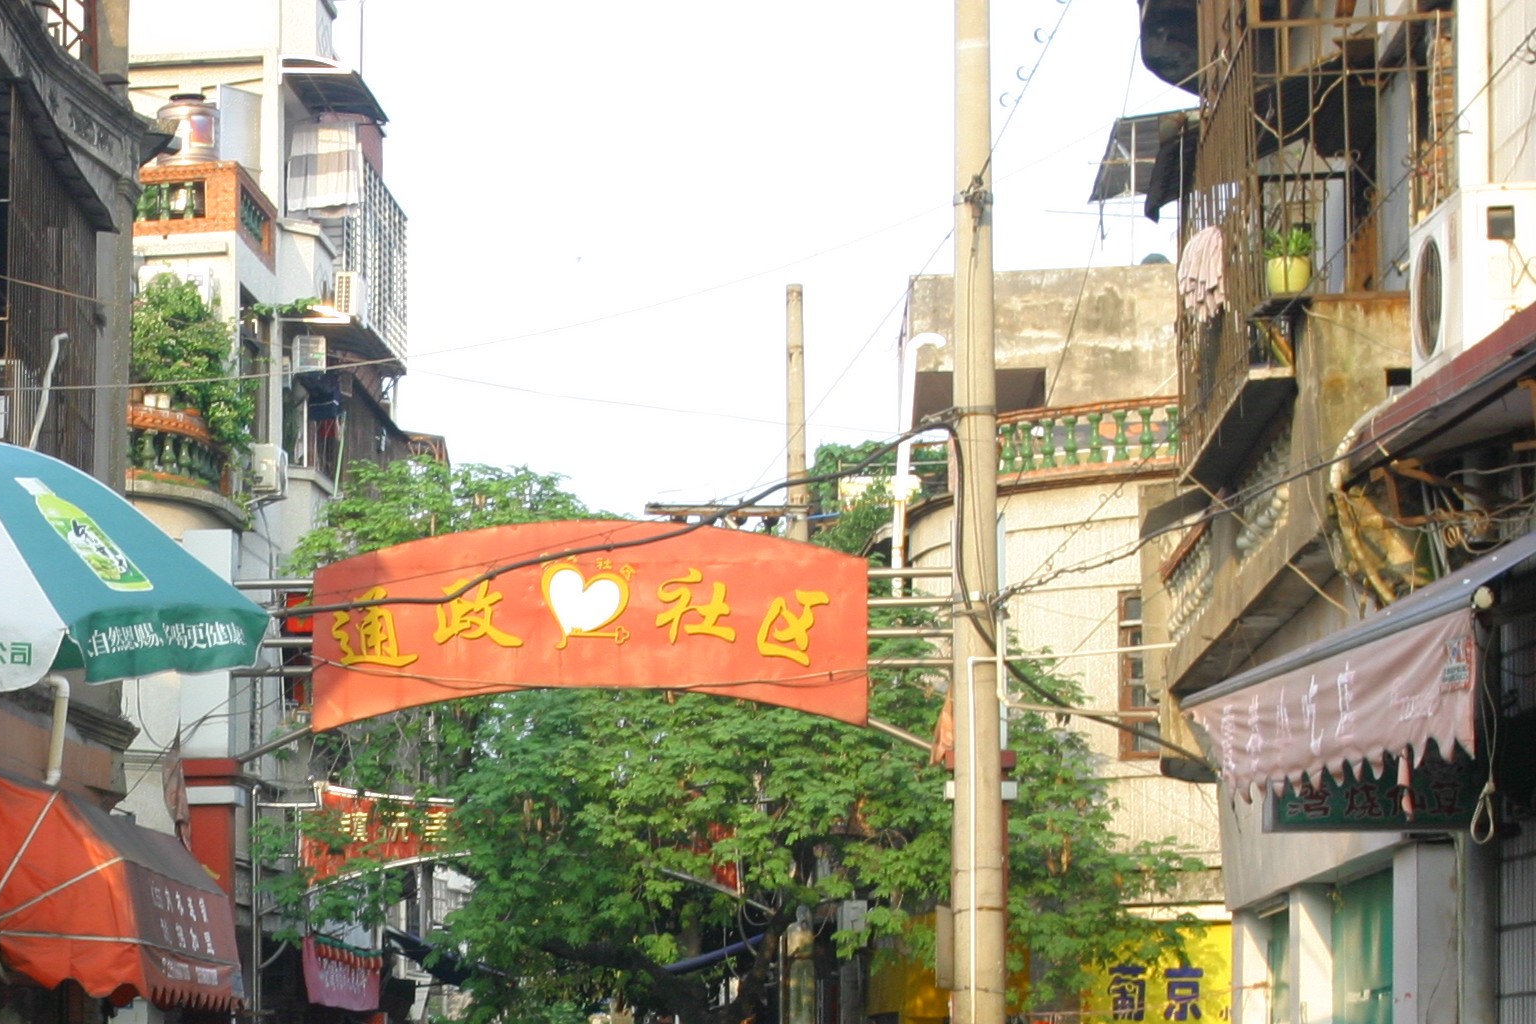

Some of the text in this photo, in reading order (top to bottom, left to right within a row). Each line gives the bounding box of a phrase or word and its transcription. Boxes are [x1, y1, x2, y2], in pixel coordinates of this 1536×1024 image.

[331, 568, 830, 668] 通政 社区
[1106, 966, 1204, 1023] 葡京
